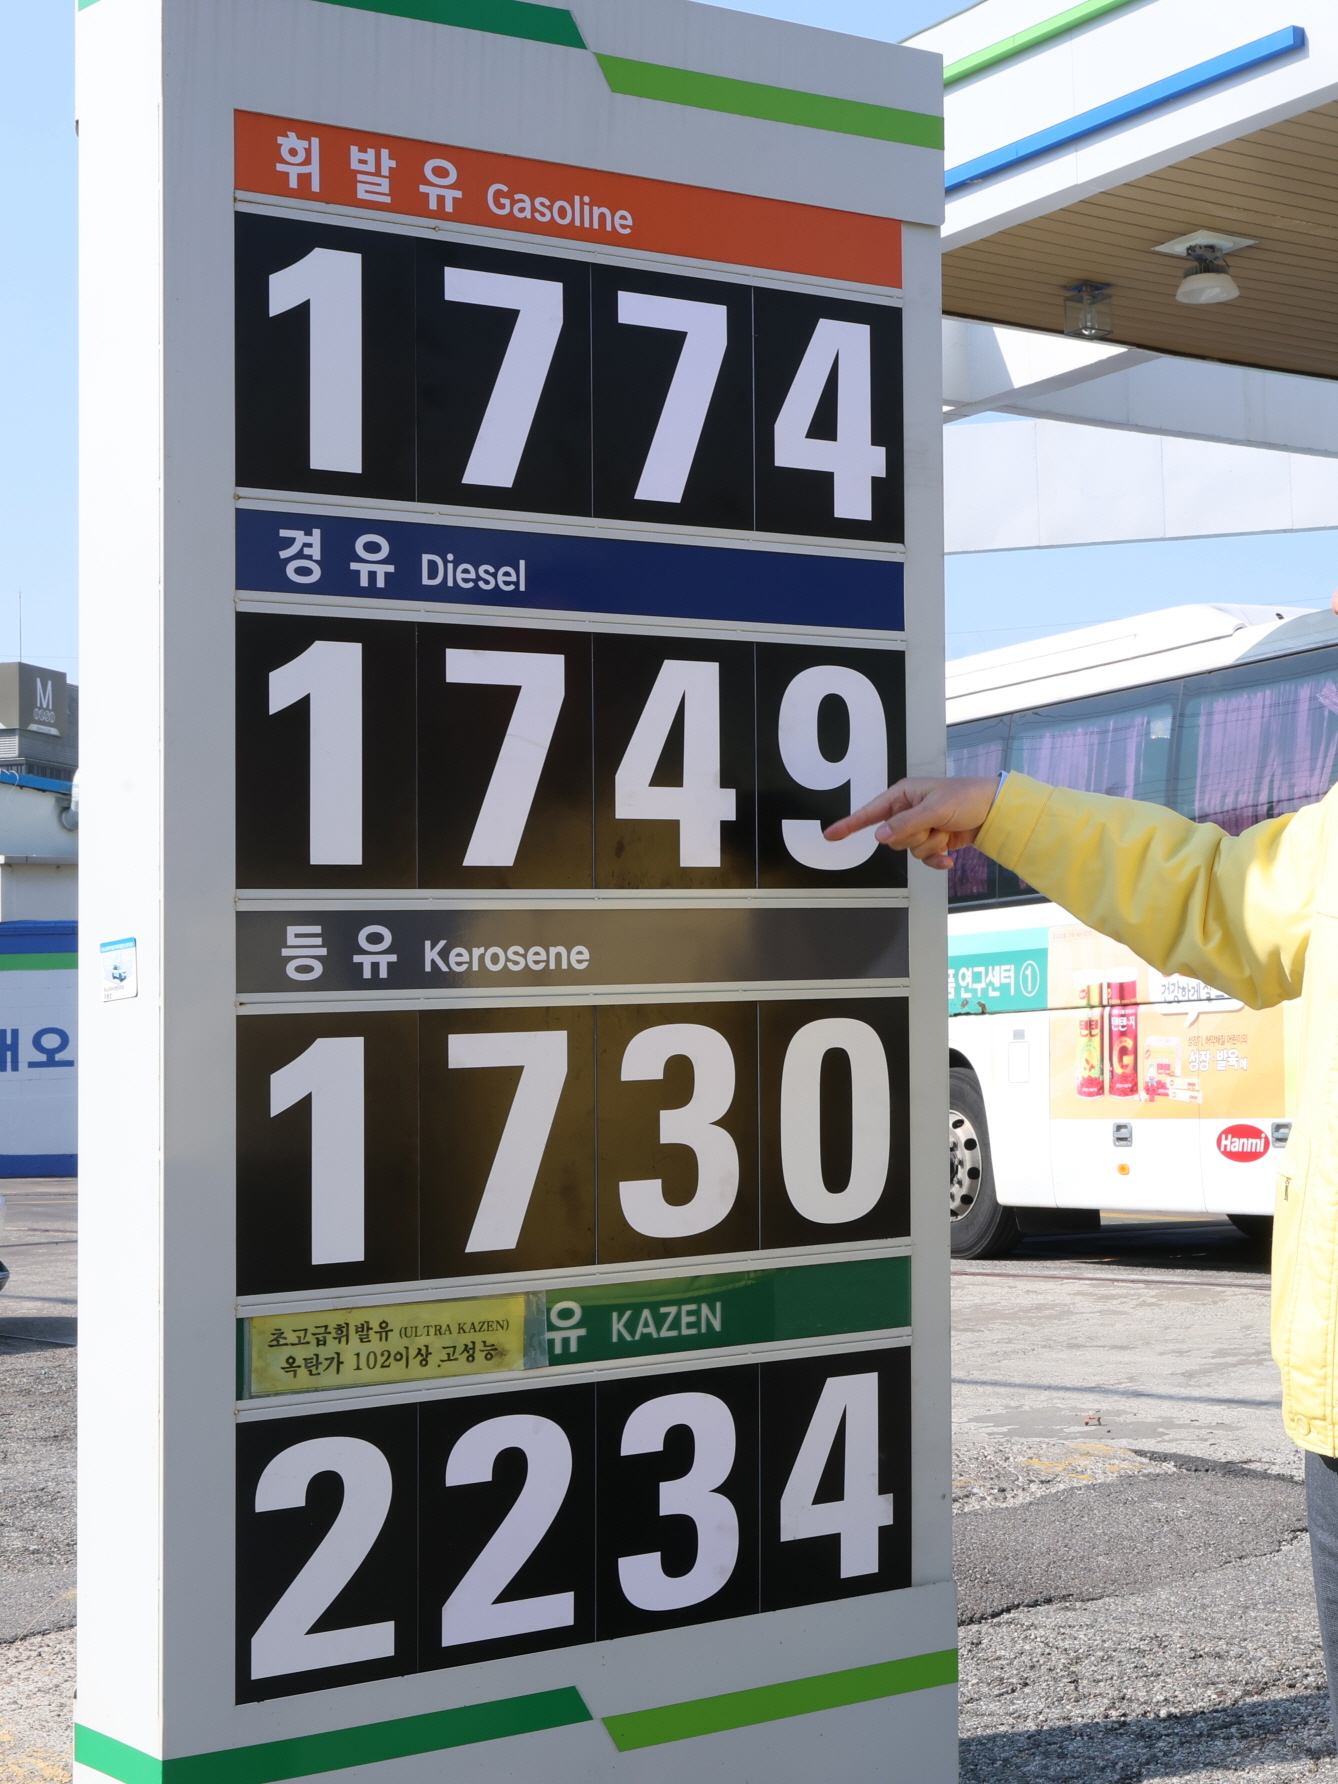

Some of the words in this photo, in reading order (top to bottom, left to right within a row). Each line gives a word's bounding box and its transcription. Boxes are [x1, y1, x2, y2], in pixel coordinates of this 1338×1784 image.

[487, 184, 633, 236] Gasoline
[268, 247, 887, 521] 1774
[421, 553, 526, 592] Diesel
[268, 640, 890, 871] 1749
[424, 939, 590, 974] Kerosene
[958, 964, 1015, 998] 연구센터
[269, 1017, 891, 1266] 1730
[1220, 1133, 1266, 1152] Hanmi
[268, 1319, 394, 1349] 초고급휘발유
[399, 1323, 453, 1340] (ULTRA
[457, 1318, 510, 1335] KAZEN)
[612, 1302, 722, 1343] KAZEN
[280, 1352, 344, 1379] 옥탄가
[251, 1372, 894, 1681] 2234
